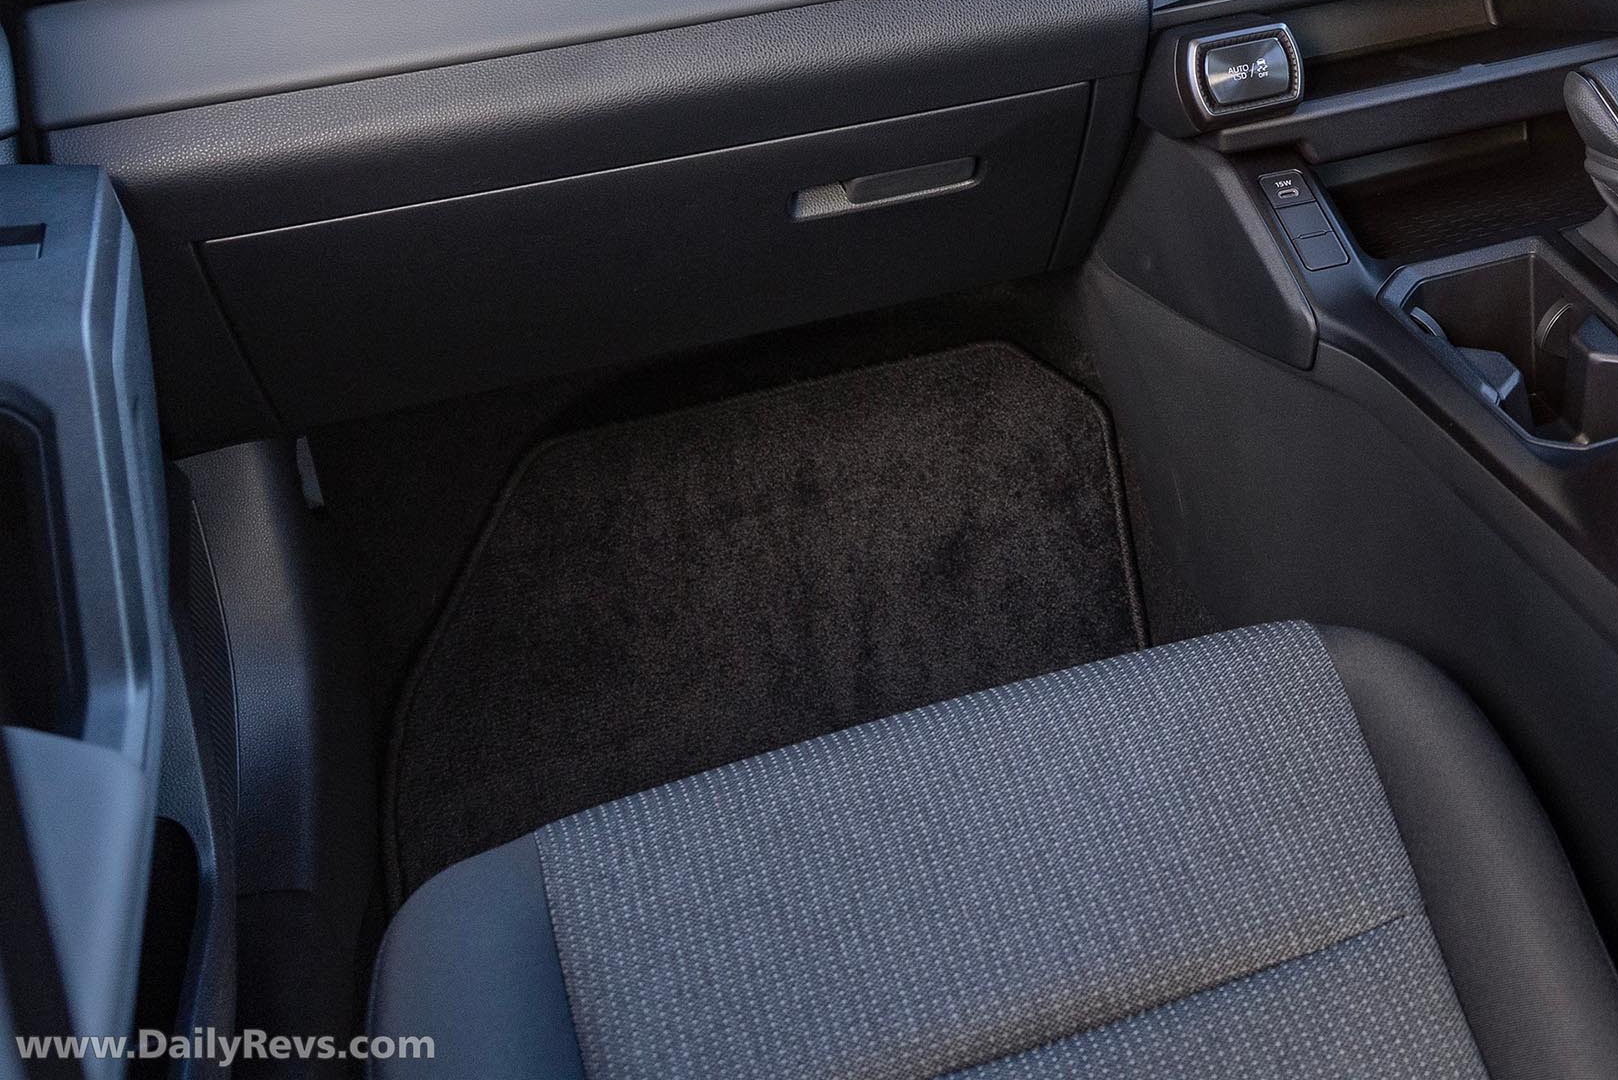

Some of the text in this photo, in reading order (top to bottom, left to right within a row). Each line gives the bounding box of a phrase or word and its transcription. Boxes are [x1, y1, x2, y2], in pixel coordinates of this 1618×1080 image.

[1228, 64, 1250, 74] AUTO
[1233, 72, 1248, 81] LSD
[1258, 71, 1269, 79] OFF
[1274, 179, 1292, 188] 15W
